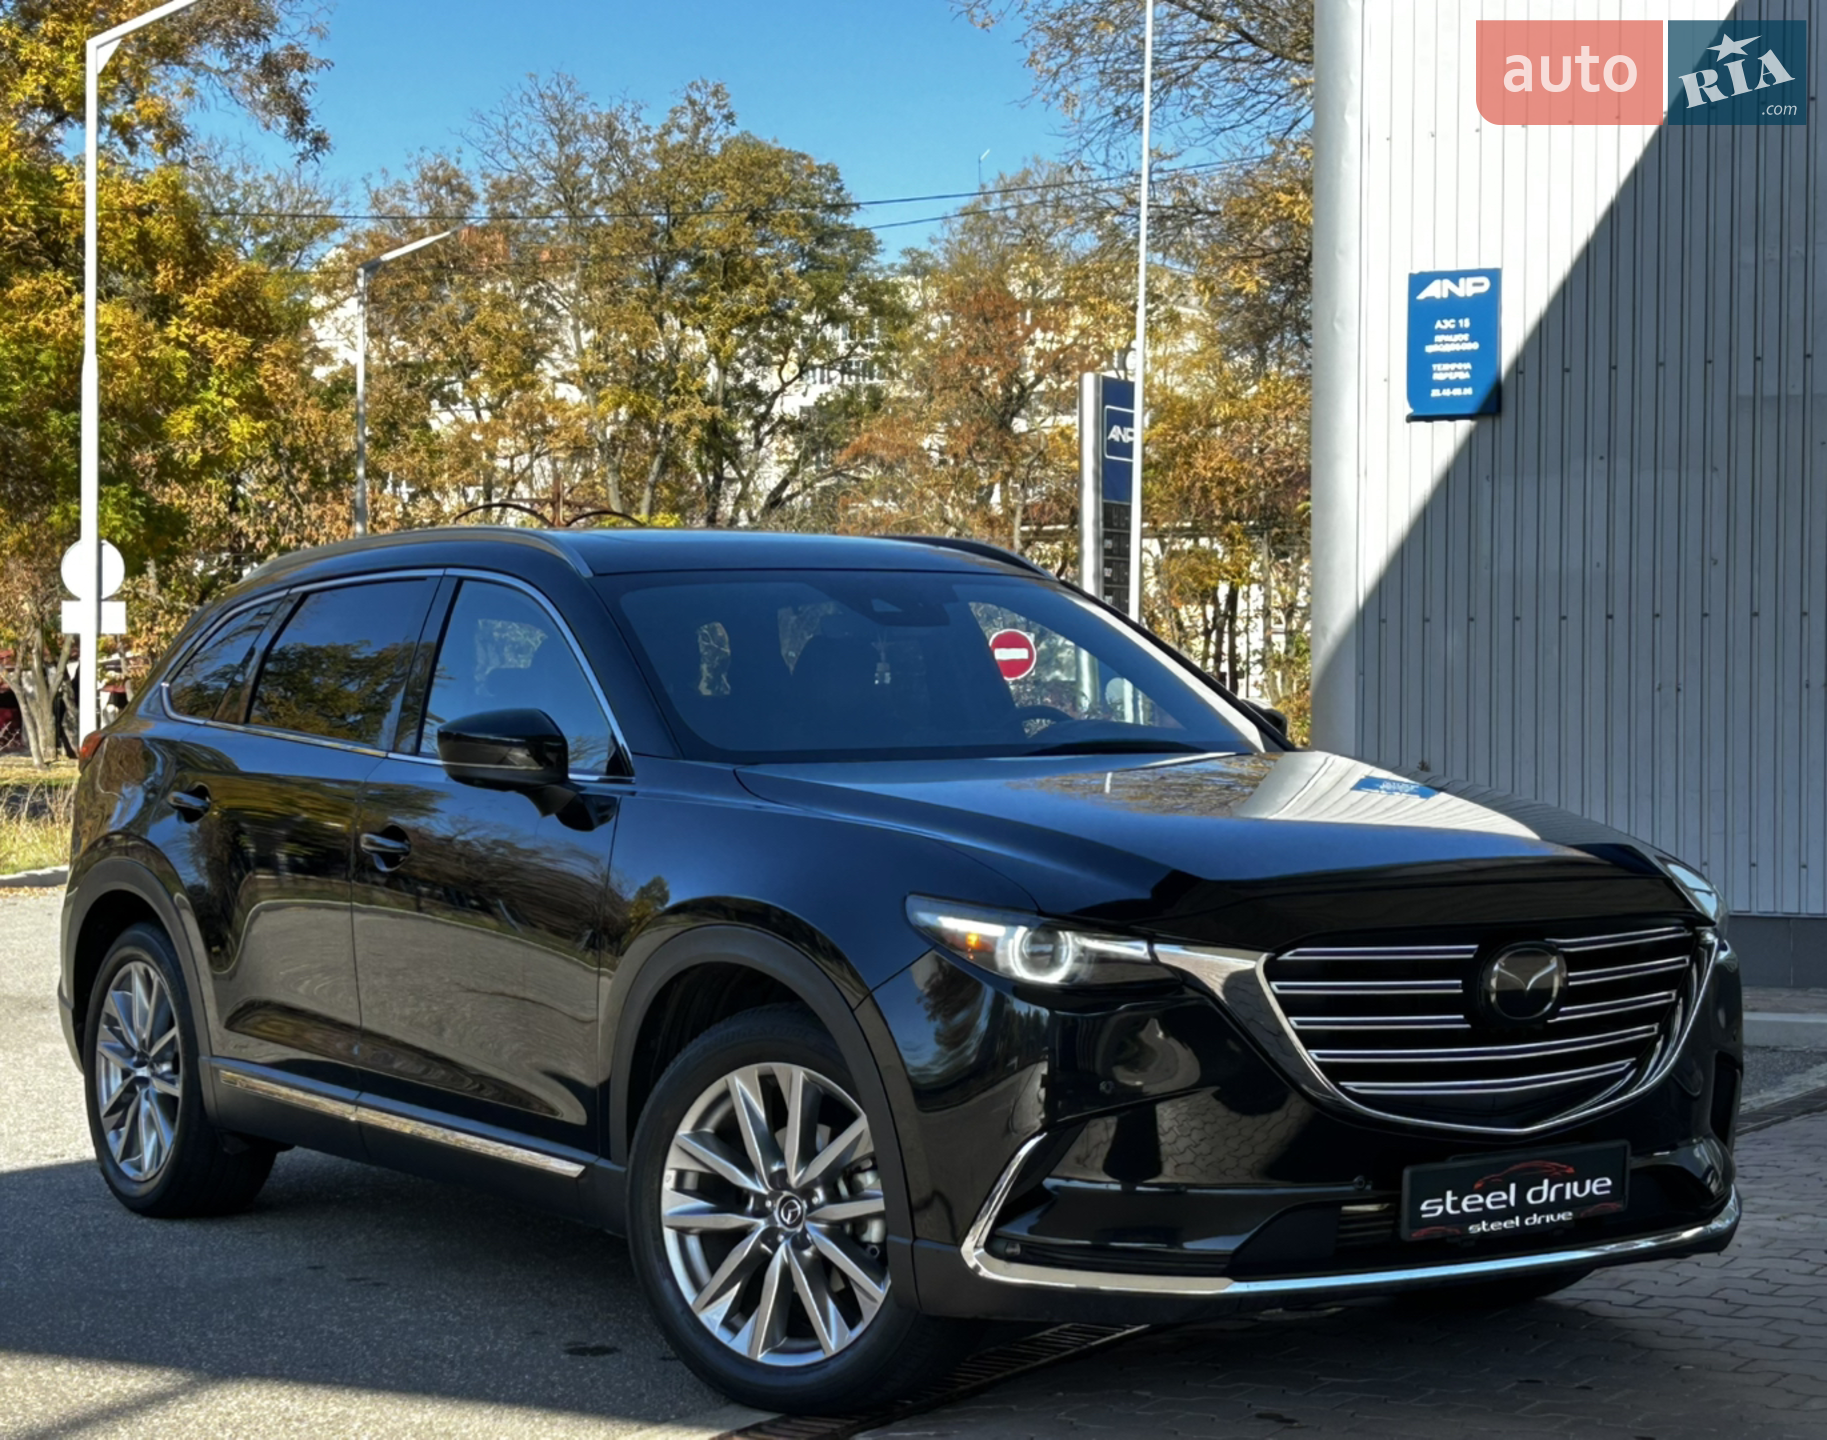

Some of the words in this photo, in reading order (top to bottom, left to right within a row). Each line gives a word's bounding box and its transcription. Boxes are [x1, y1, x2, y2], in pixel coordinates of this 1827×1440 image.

[1415, 276, 1491, 300] ANP
[1419, 1182, 1517, 1218] steel
[1525, 1176, 1613, 1205] drive
[1468, 1215, 1520, 1234] steel
[1523, 1210, 1574, 1227] drive
